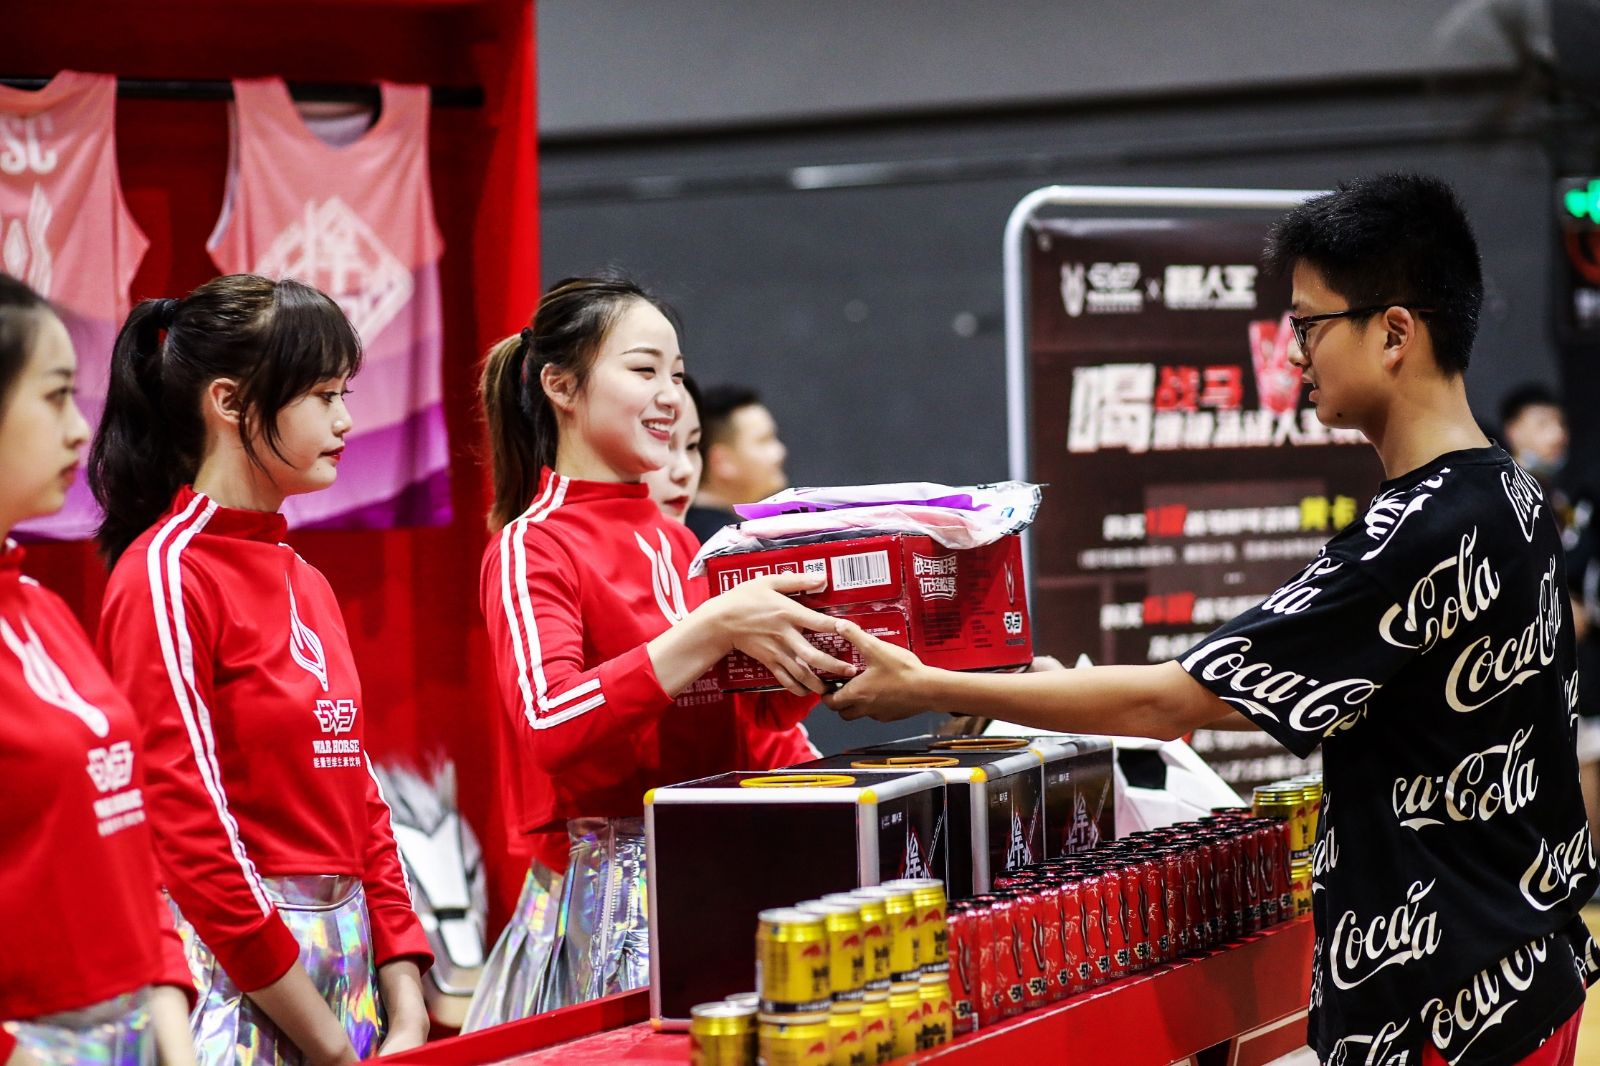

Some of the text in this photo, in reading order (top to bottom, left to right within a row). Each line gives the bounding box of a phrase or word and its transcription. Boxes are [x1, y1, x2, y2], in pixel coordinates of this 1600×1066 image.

[1445, 554, 1563, 714] Coca-Cola
[312, 739, 360, 754] WAR HORSE
